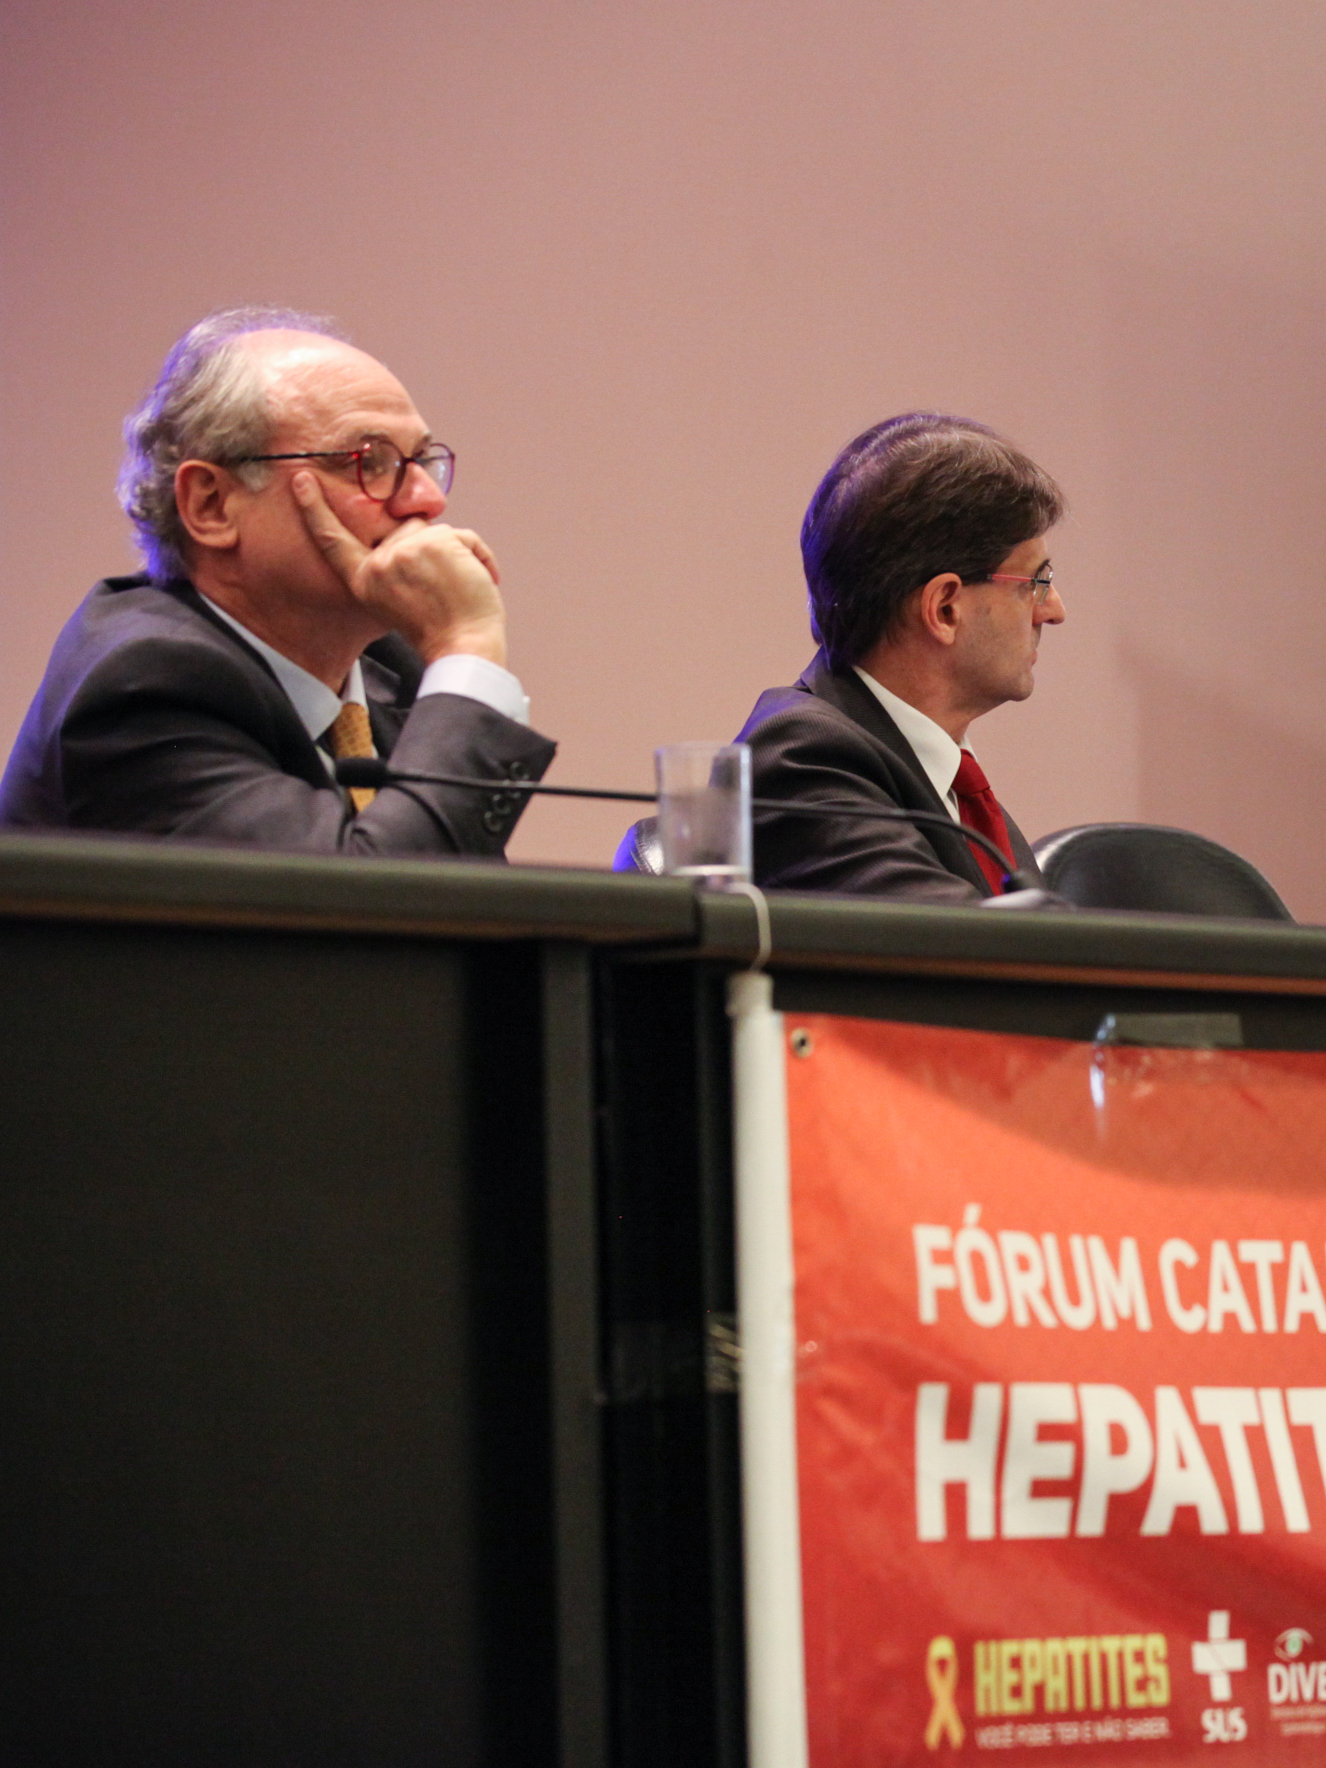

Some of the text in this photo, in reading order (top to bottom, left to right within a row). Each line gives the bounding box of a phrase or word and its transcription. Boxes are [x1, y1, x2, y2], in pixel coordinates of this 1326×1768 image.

[912, 1203, 1152, 1330] FÓRUM
[974, 1633, 1170, 1716] HEPATITES
[1203, 1708, 1248, 1742] SUS
